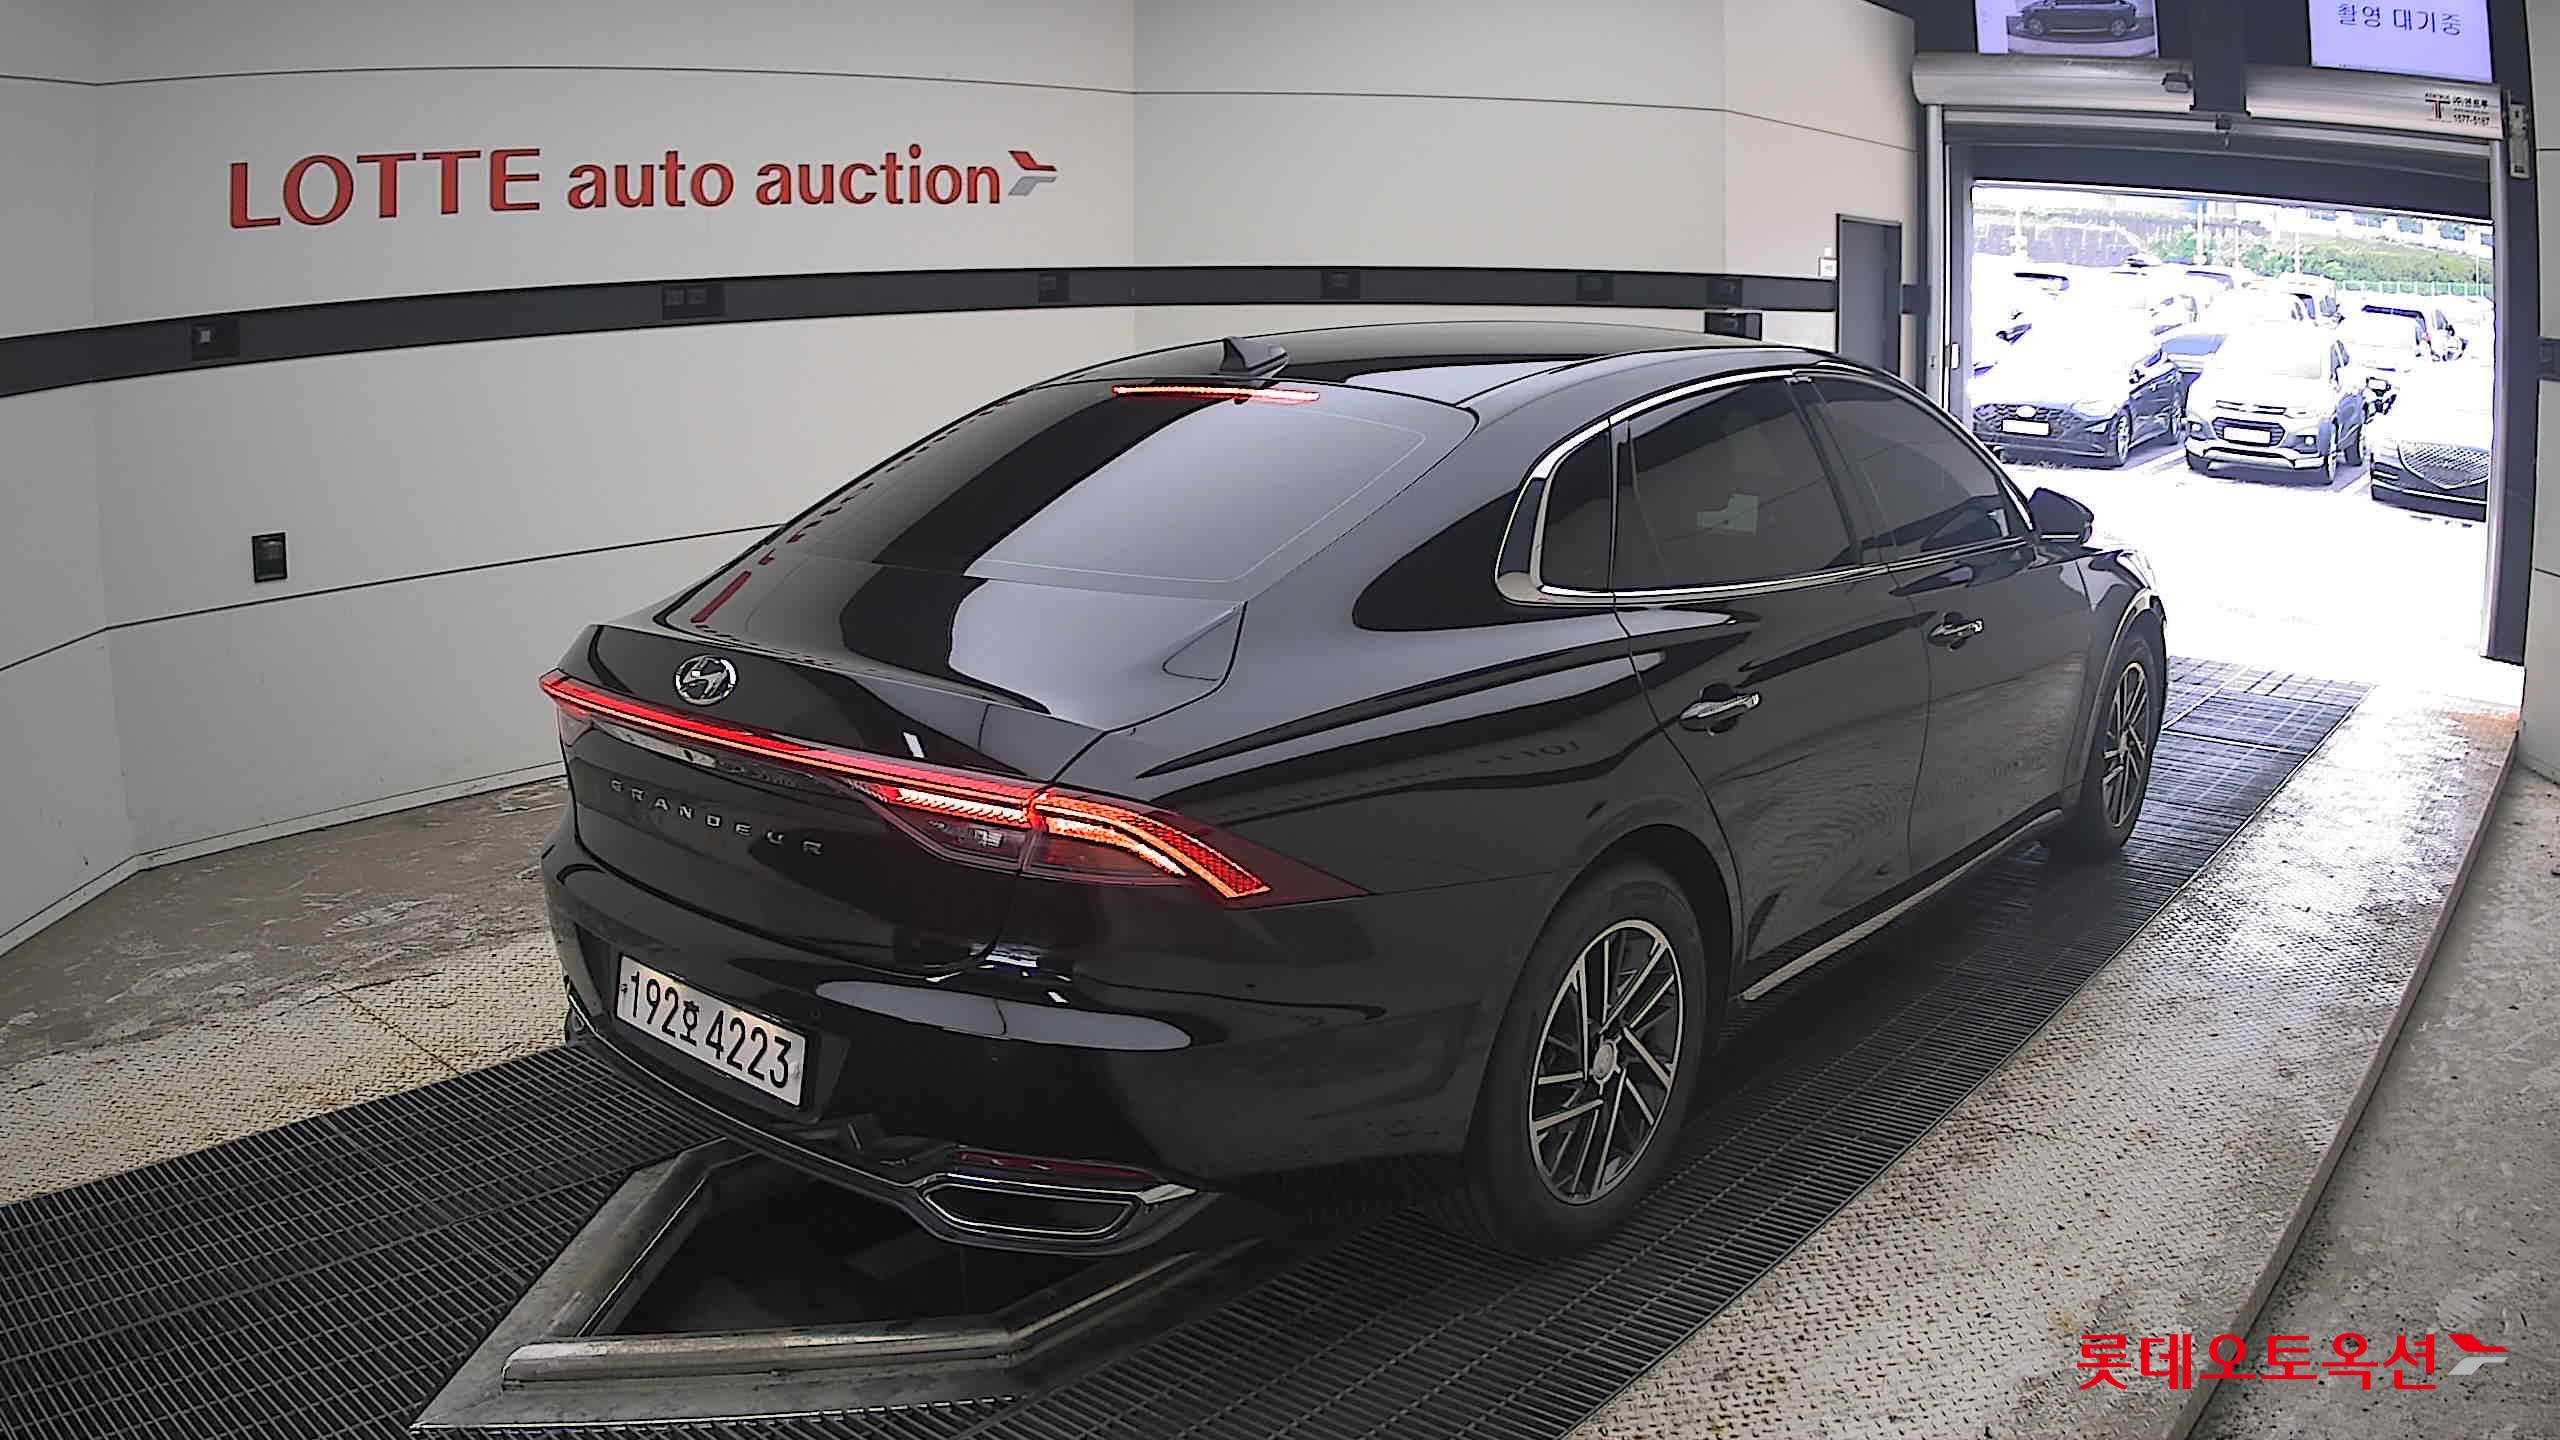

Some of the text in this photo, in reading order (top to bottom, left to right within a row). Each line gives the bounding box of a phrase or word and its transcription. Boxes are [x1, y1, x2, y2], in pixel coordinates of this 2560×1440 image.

[2338, 4, 2462, 36] 촬영 대기중
[229, 144, 1002, 230] LOTTE auto auction
[610, 778, 824, 856] GRANDEUR
